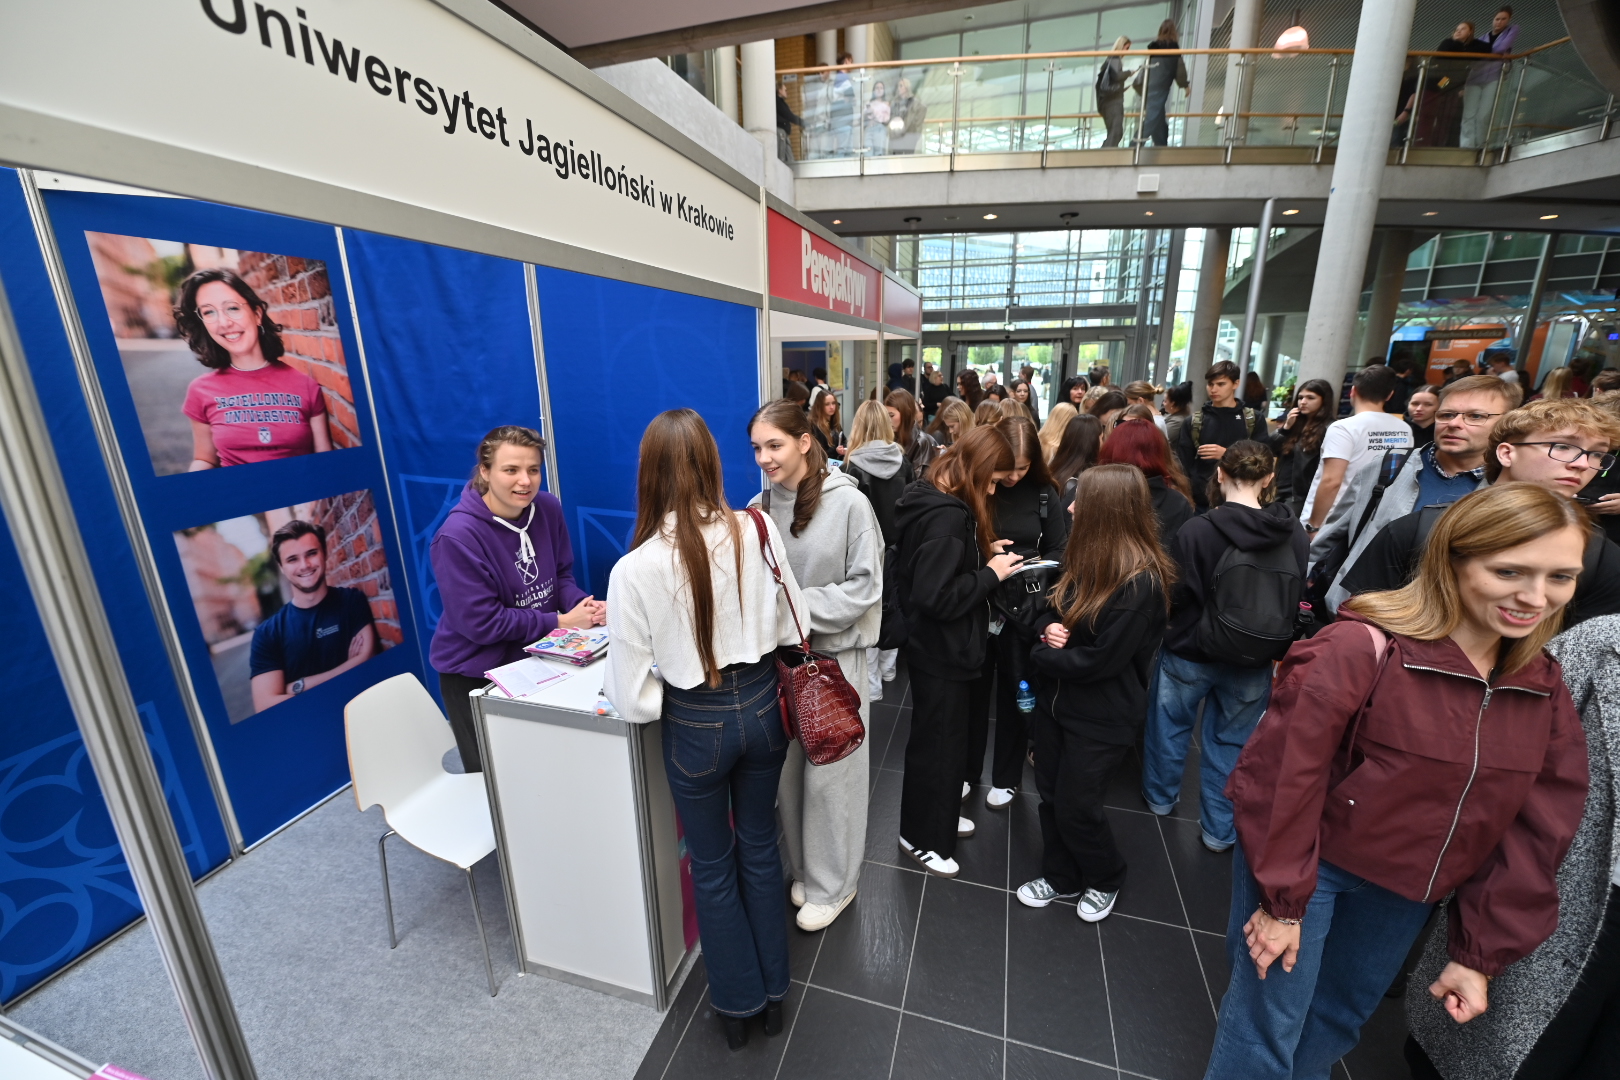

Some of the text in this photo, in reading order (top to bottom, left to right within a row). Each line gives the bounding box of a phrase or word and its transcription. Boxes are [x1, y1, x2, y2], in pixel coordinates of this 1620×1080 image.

[200, 0, 734, 241] Uniwersytet Jagielloński w Krakowie
[801, 228, 867, 318] Perspektywy
[215, 393, 302, 409] JAGIELLONIAN
[225, 409, 301, 424] UNIVERSITY
